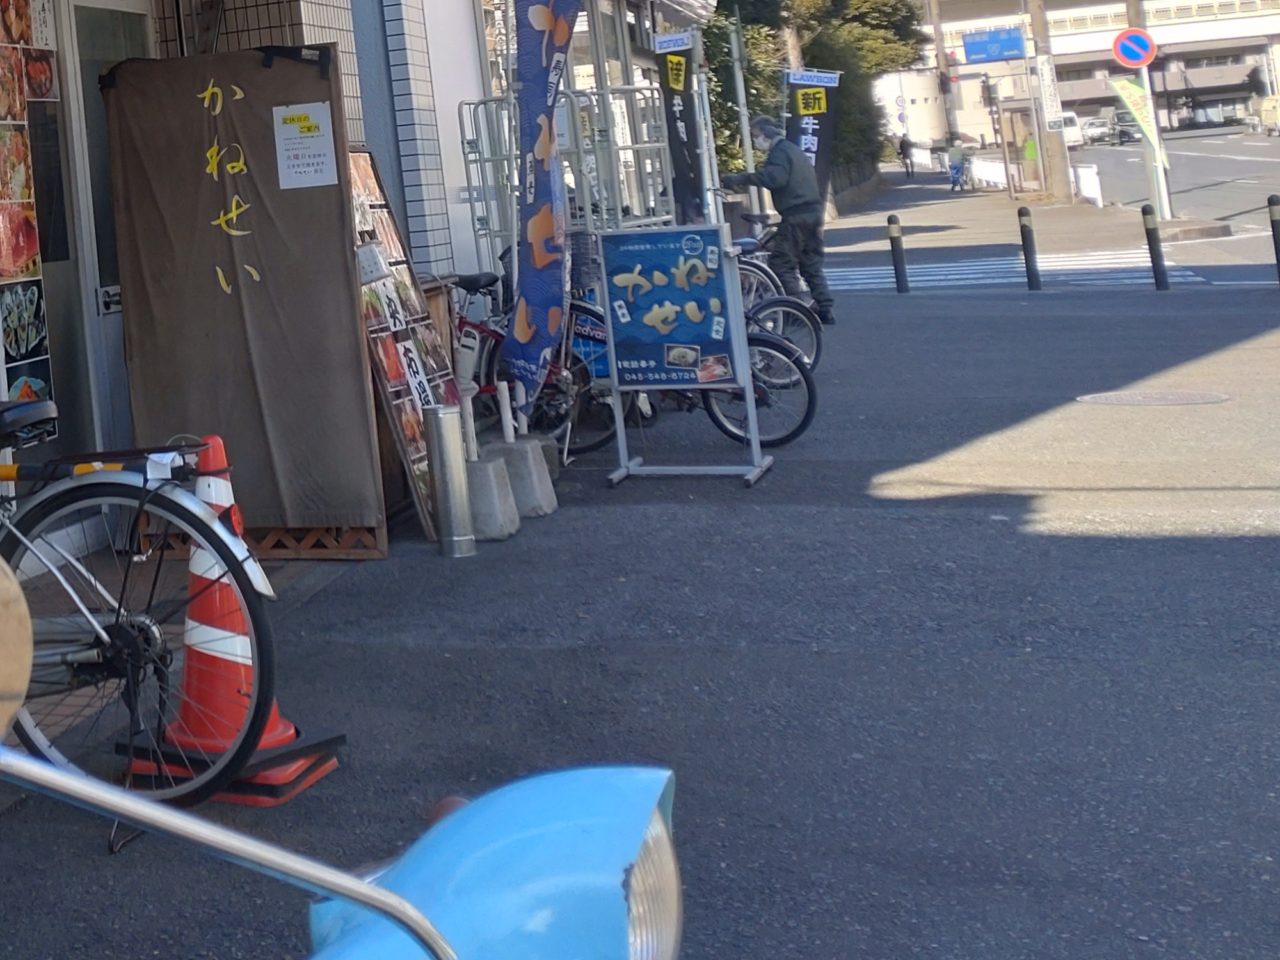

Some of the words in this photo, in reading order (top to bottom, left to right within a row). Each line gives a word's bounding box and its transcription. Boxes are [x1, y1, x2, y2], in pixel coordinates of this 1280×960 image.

[792, 74, 838, 85] LAWSON
[801, 91, 823, 111] 新
[196, 77, 261, 295] かねせい
[612, 255, 716, 303] かね
[643, 297, 722, 335] せい
